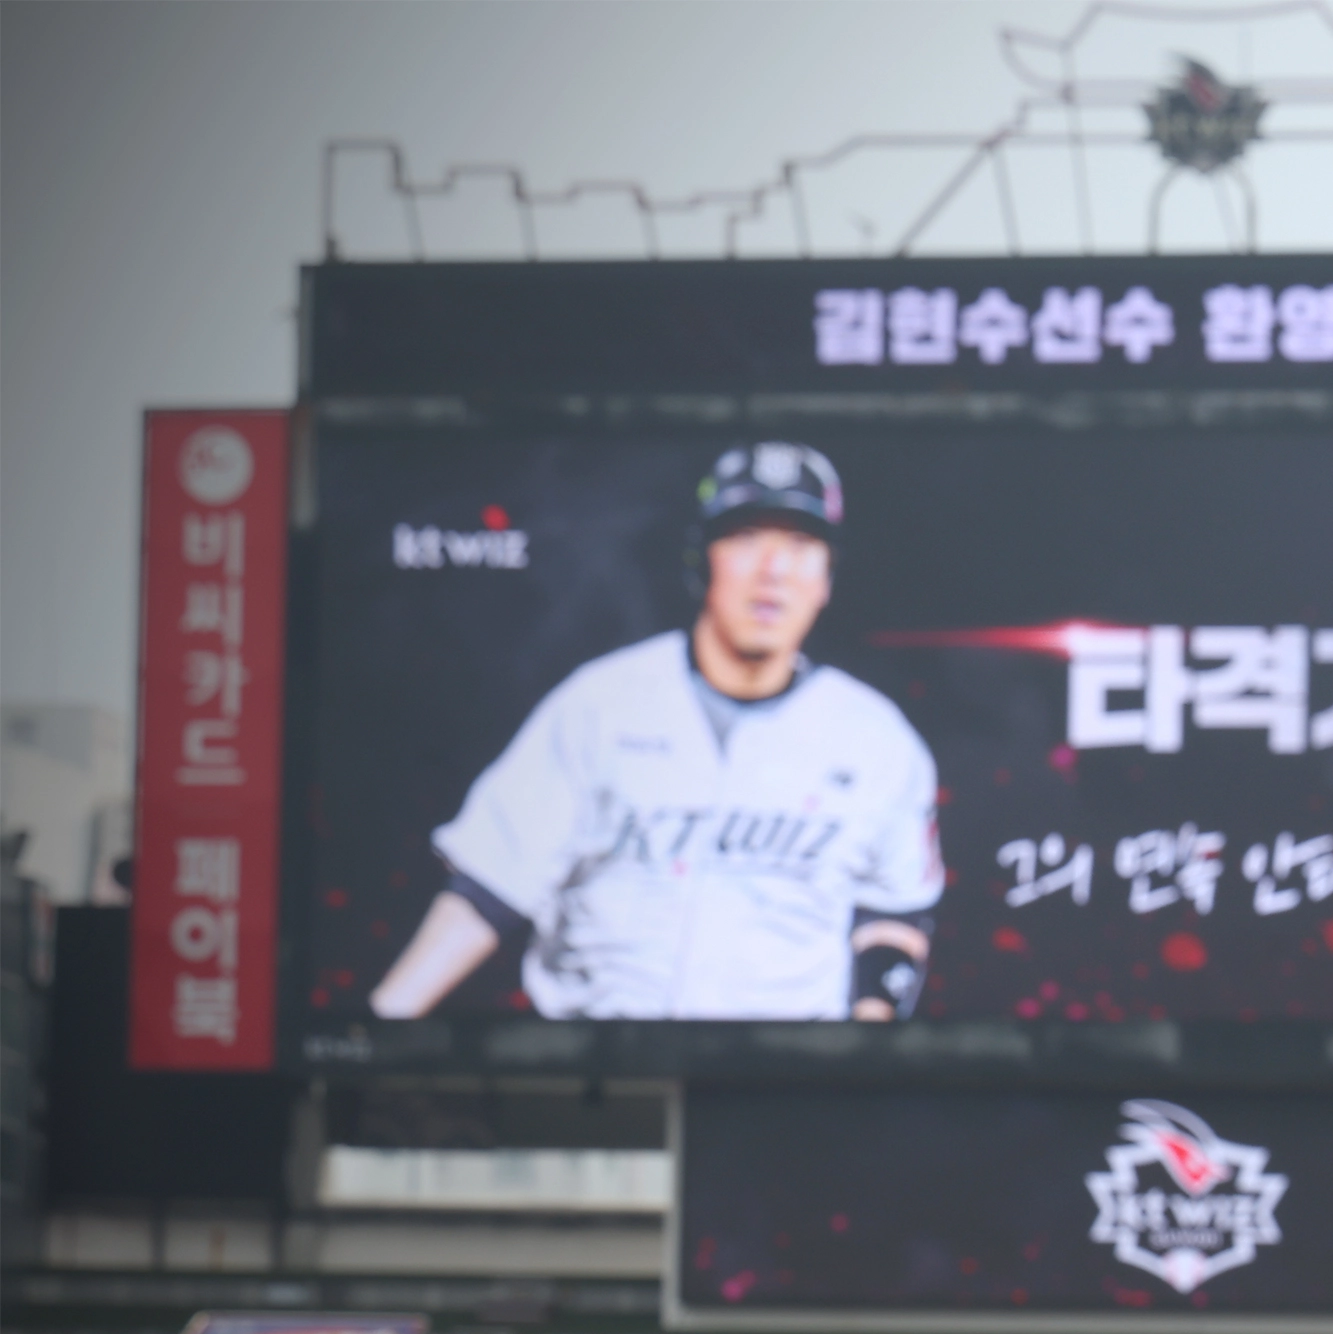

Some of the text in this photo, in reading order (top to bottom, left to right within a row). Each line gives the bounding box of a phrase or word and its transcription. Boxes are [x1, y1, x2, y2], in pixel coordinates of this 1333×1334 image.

[814, 285, 1175, 365] 김현수선수
[175, 511, 248, 787] 비씨카드
[996, 831, 1094, 909] 그의
